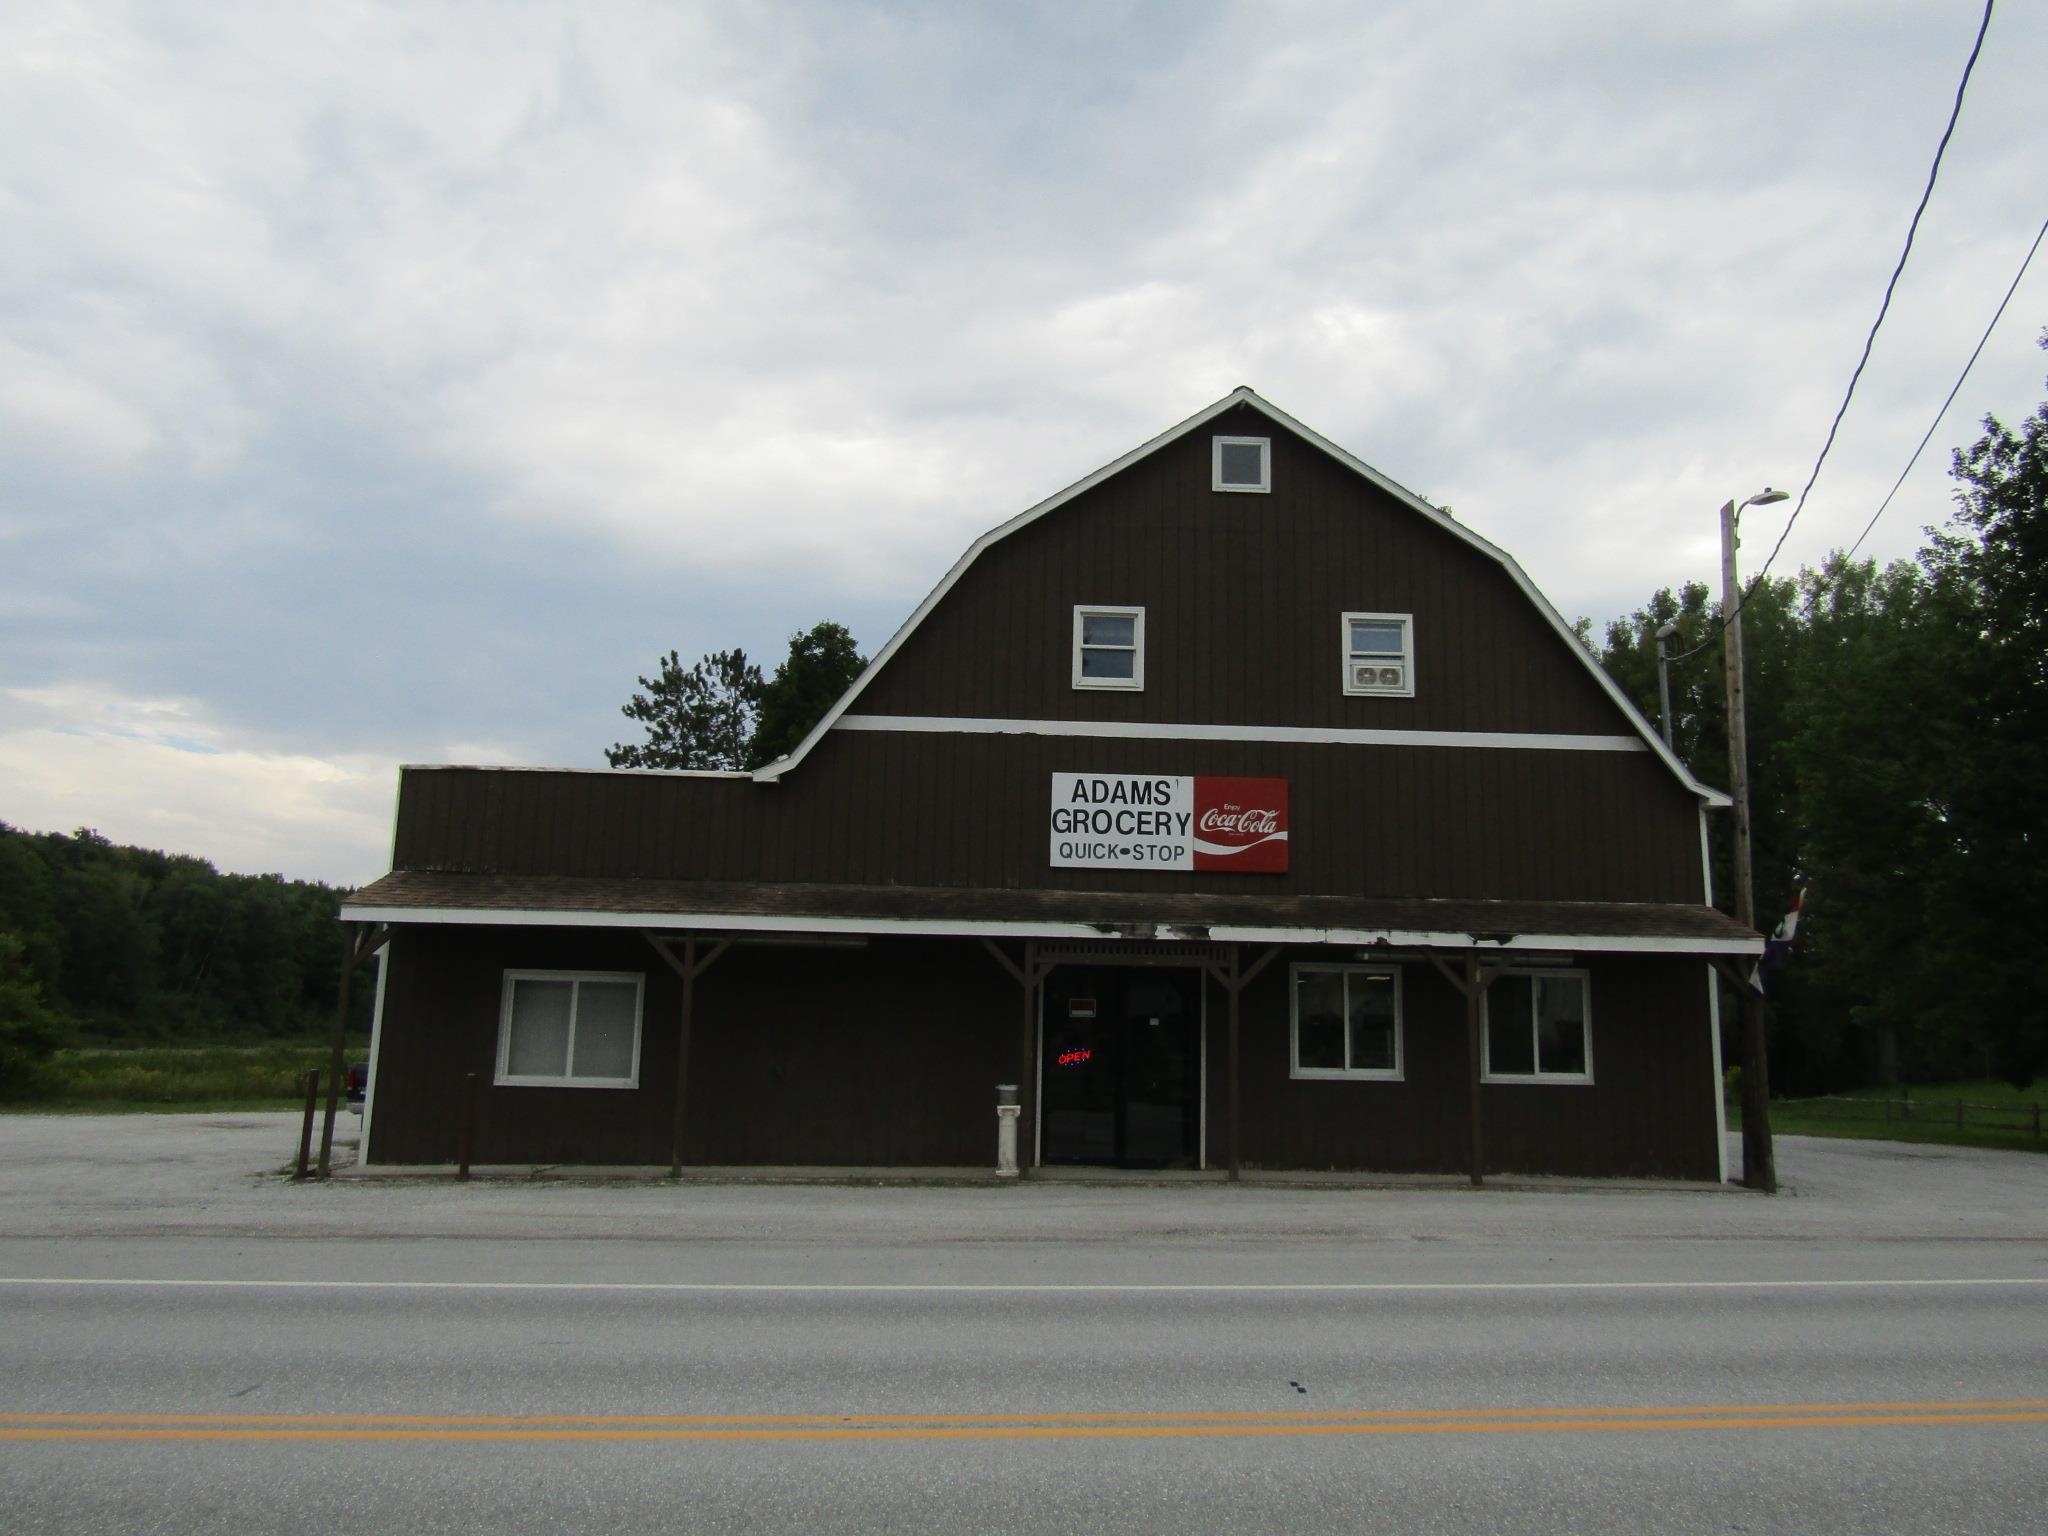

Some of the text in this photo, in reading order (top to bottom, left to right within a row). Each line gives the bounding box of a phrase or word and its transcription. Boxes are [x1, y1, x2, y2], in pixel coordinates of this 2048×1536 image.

[1052, 808, 1191, 836] GROCERY
[1200, 808, 1280, 833] Coca-Cola
[1058, 1050, 1091, 1065] OPEN
